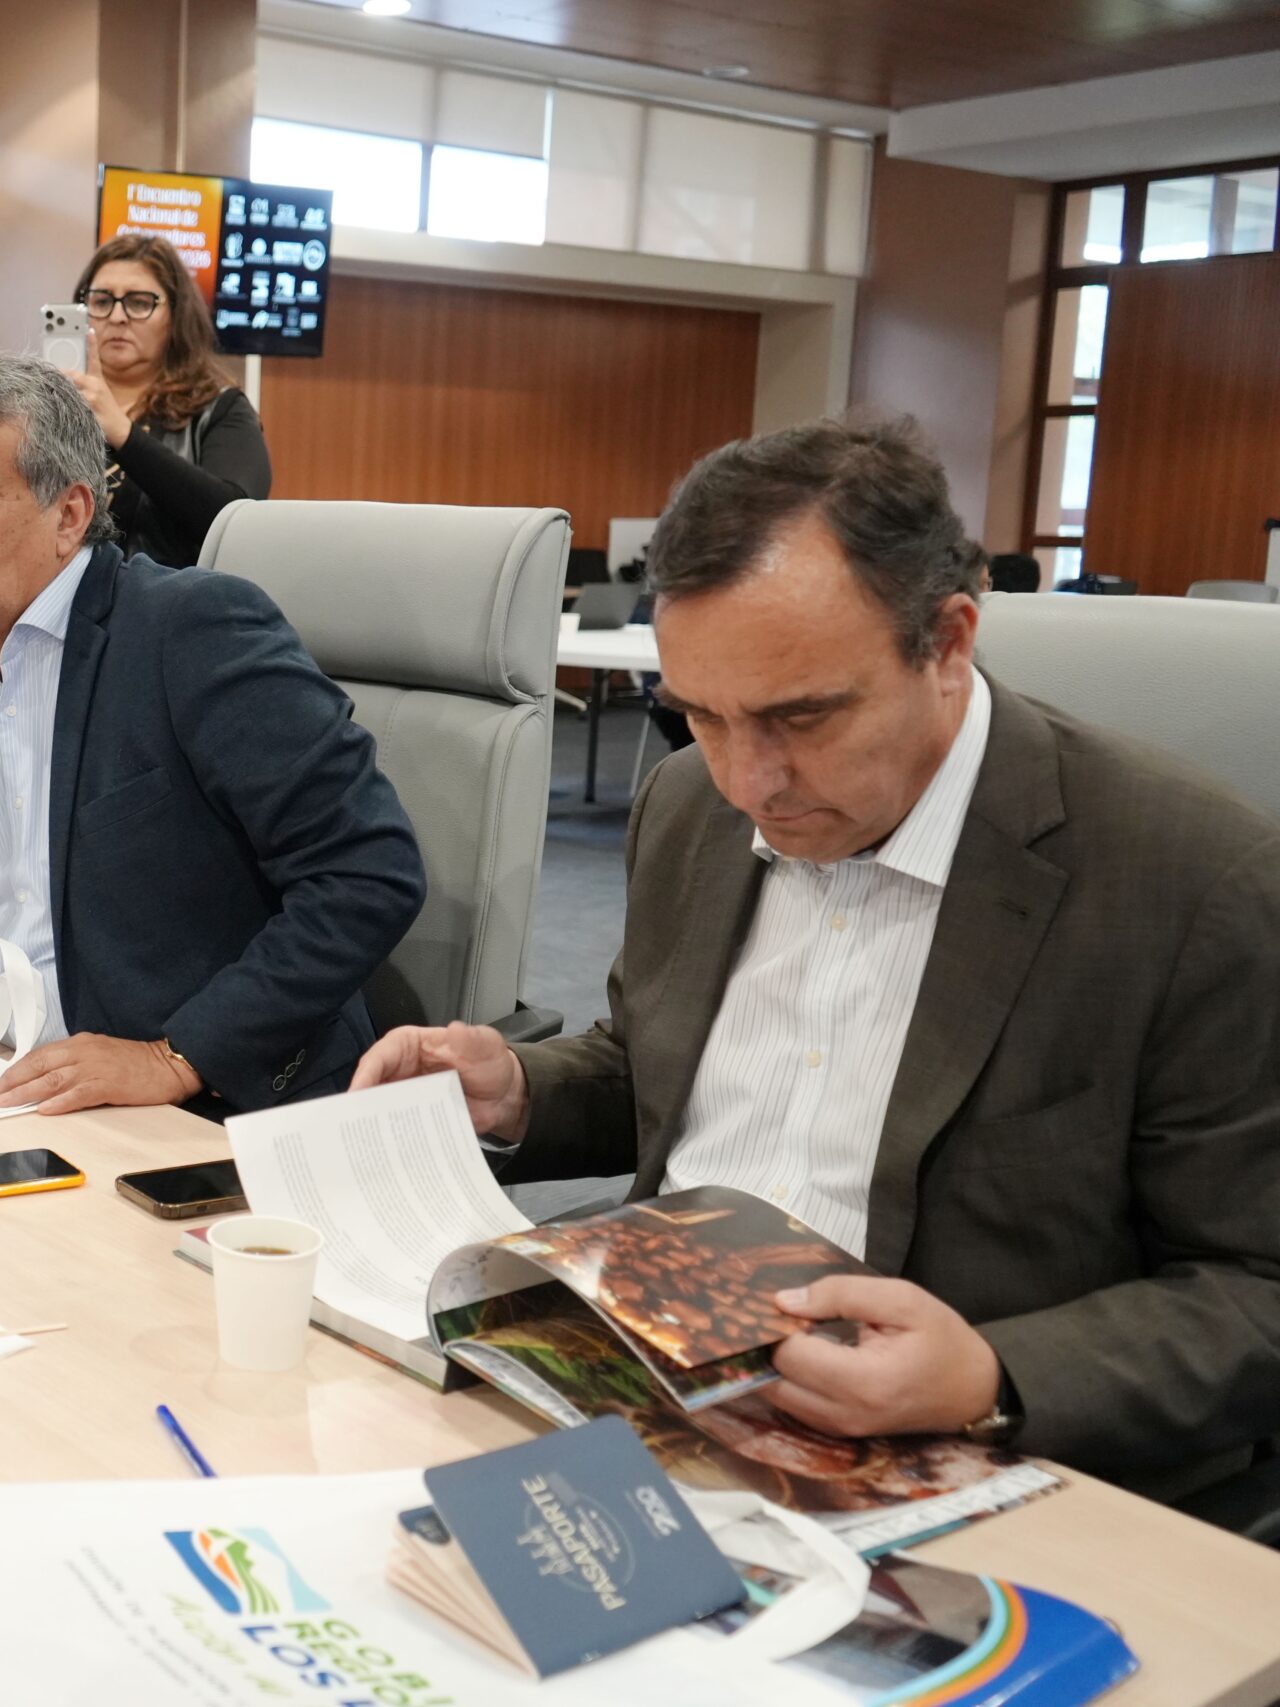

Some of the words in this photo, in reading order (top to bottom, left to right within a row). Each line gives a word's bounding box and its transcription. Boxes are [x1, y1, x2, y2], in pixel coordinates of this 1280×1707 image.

[128, 205, 182, 226] Nacional
[181, 209, 198, 227] de
[136, 184, 202, 207] Encuentro
[521, 1474, 627, 1611] PASAPORTE
[239, 1625, 346, 1688] LOS
